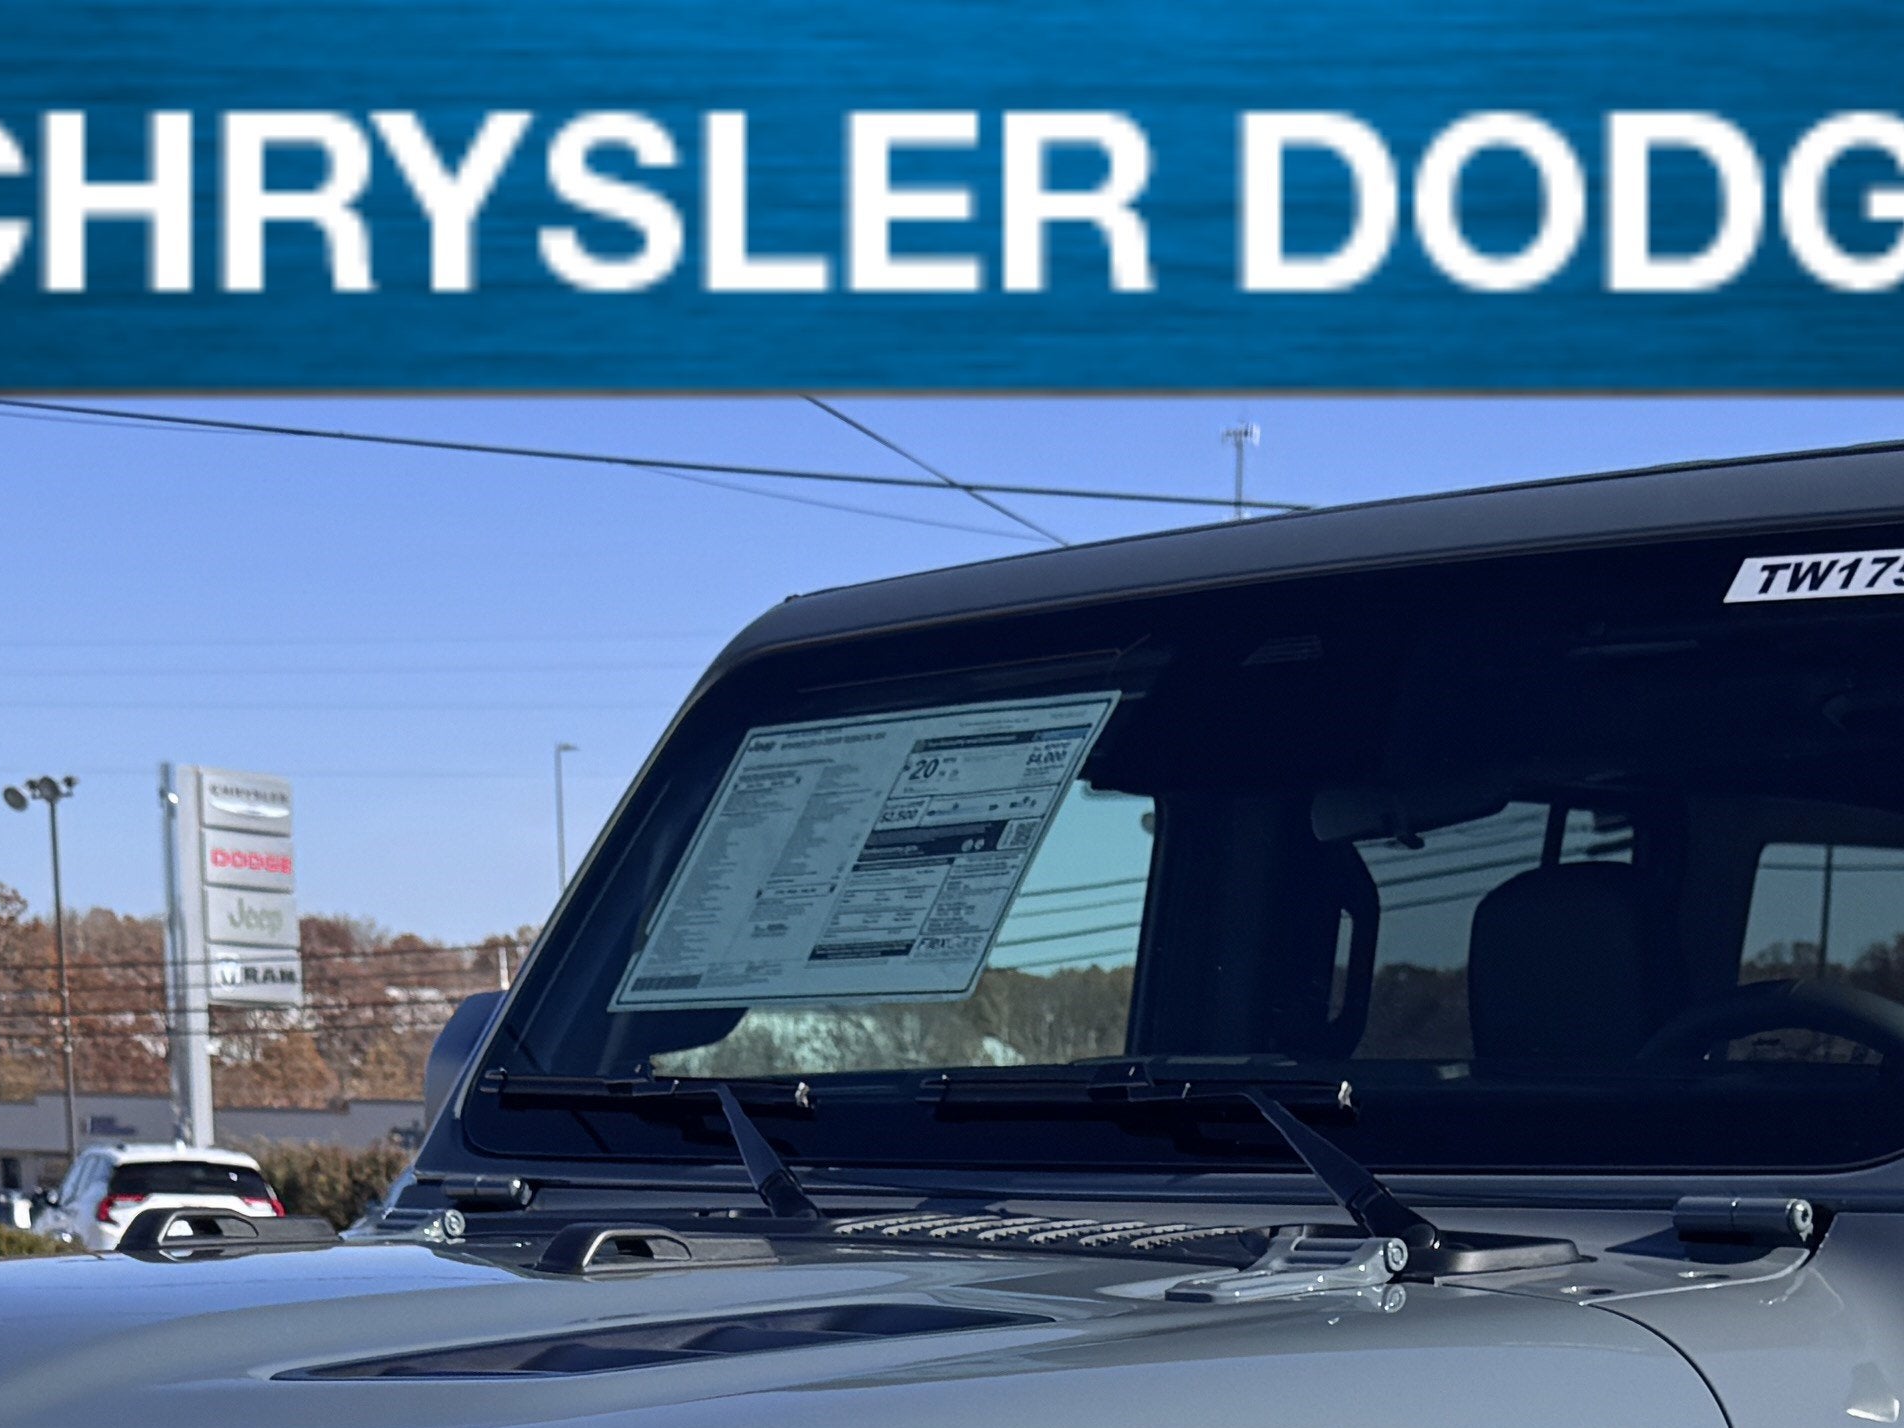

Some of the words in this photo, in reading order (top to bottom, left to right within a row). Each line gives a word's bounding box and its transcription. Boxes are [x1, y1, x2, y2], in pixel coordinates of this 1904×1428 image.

[908, 758, 939, 781] 20
[210, 847, 293, 875] DODGE
[227, 897, 284, 937] Jeep
[242, 965, 297, 985] RAM
